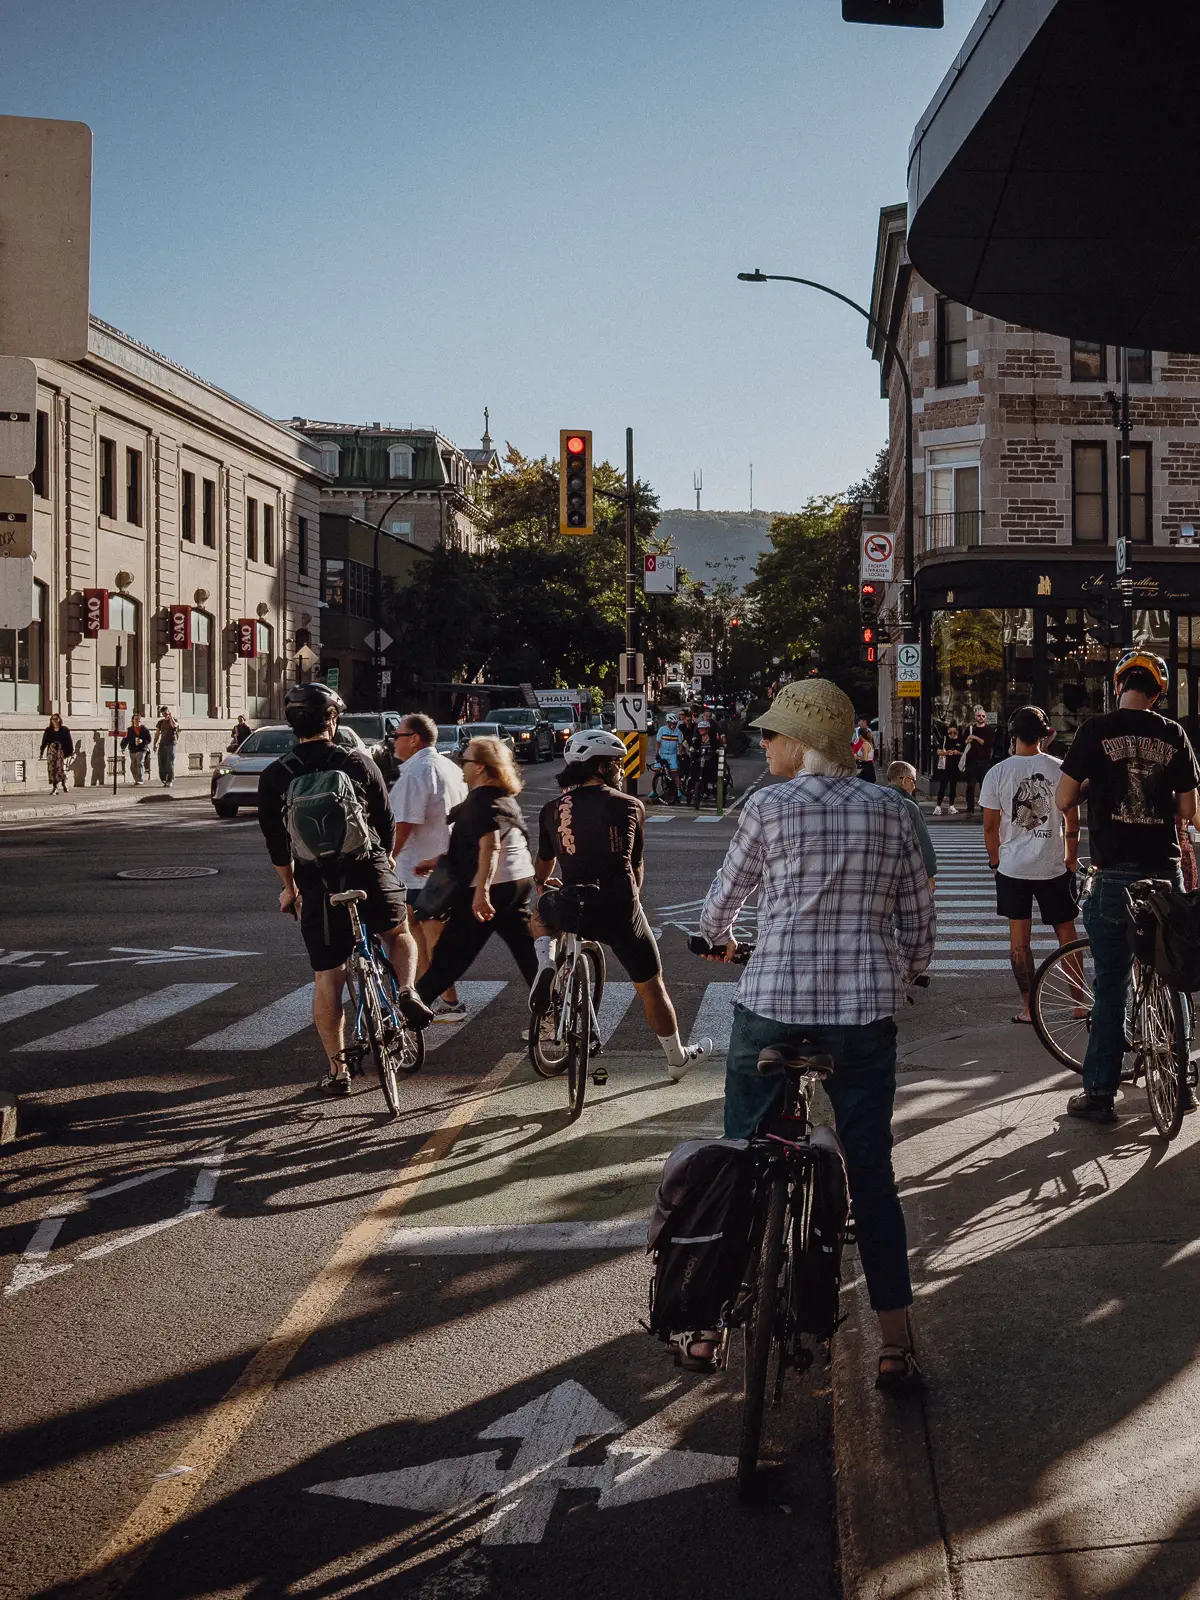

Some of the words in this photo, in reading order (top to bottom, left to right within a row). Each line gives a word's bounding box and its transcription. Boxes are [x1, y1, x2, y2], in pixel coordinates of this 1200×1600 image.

[88, 597, 101, 631] SAQ
[174, 612, 186, 642] SAQ
[241, 624, 252, 651] SAQ
[695, 658, 710, 669] 30
[1101, 735, 1151, 755] ALLIGAOR
[1034, 829, 1052, 838] VANS
